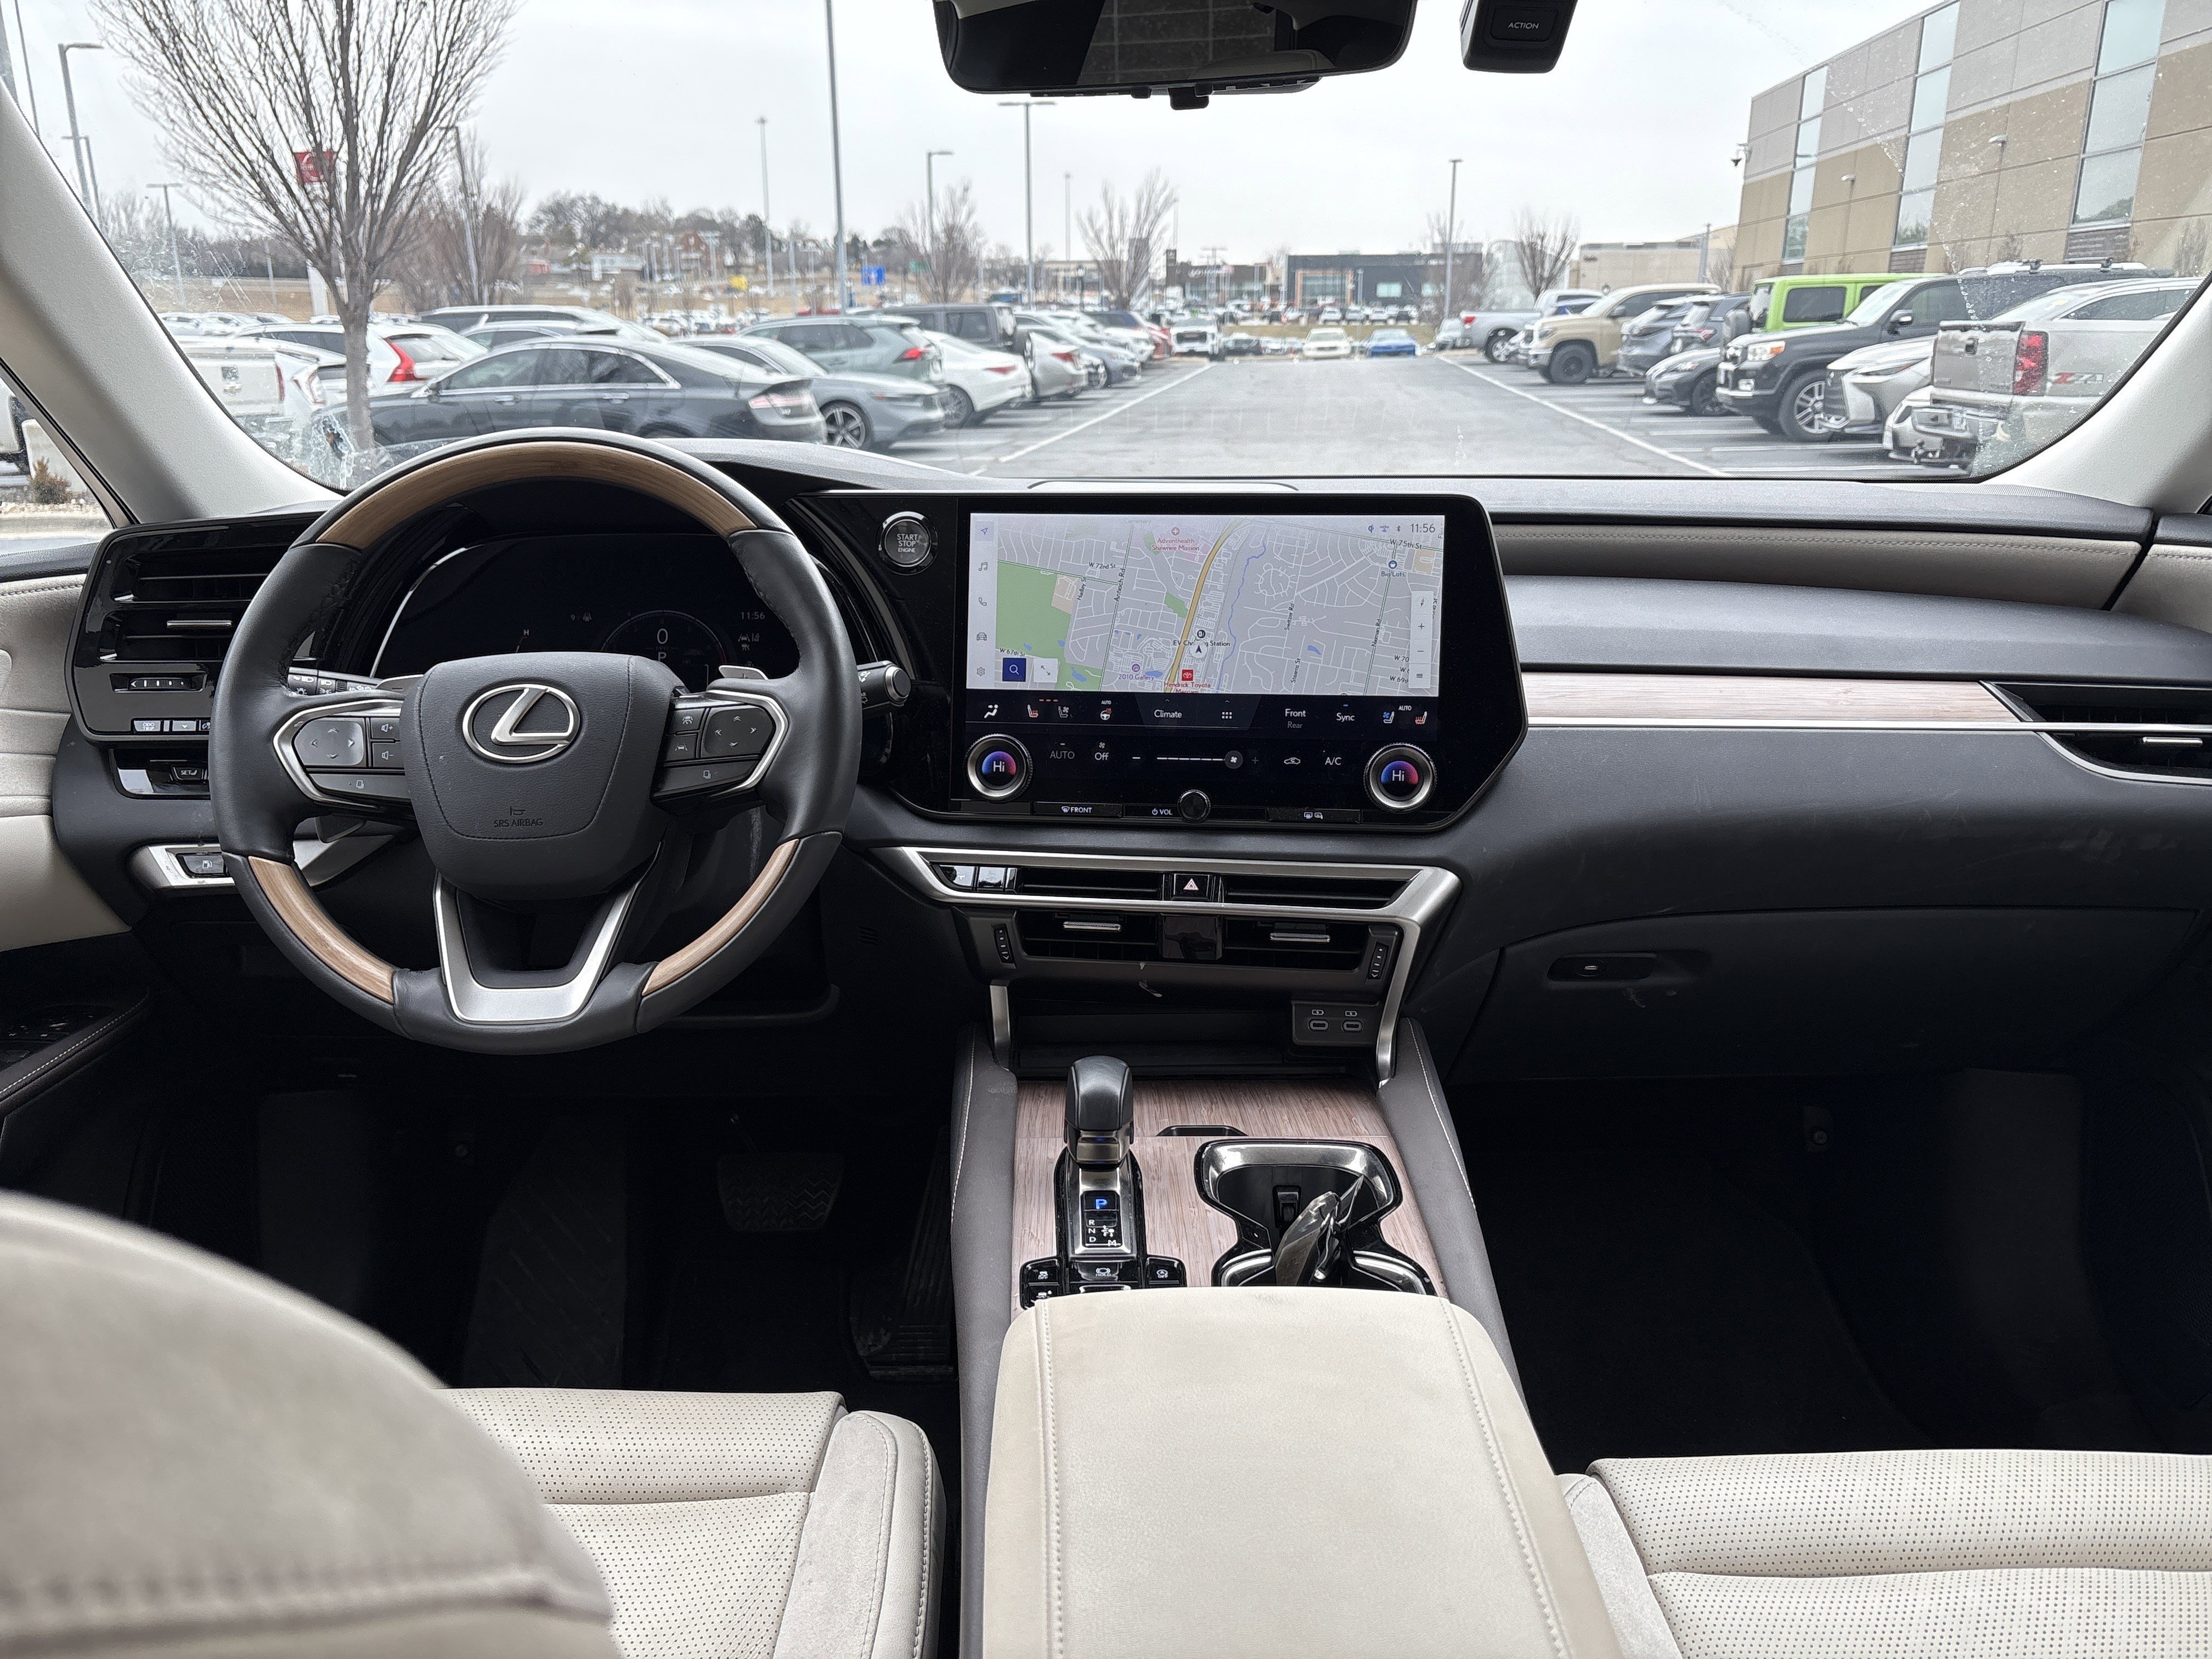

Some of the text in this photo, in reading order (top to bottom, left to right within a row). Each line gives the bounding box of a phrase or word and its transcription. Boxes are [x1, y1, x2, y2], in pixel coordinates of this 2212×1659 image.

[1410, 523, 1436, 533] 11:56
[1398, 540, 1414, 548] 75th
[1114, 568, 1126, 602] Antioch Rd
[1284, 603, 1295, 631] Switzer Rd
[1375, 618, 1382, 627] Rd
[657, 628, 668, 645] 0
[1154, 709, 1182, 719] Climate
[1285, 708, 1306, 718] Front
[1336, 713, 1355, 723] Sync
[1049, 751, 1075, 759] AUTO
[1094, 752, 1109, 761] Off
[993, 761, 1005, 772] Hi
[1324, 757, 1342, 766] A/C
[1392, 770, 1404, 781] Hi
[494, 818, 543, 827] SRS AIRBAG
[1095, 1198, 1108, 1210] P
